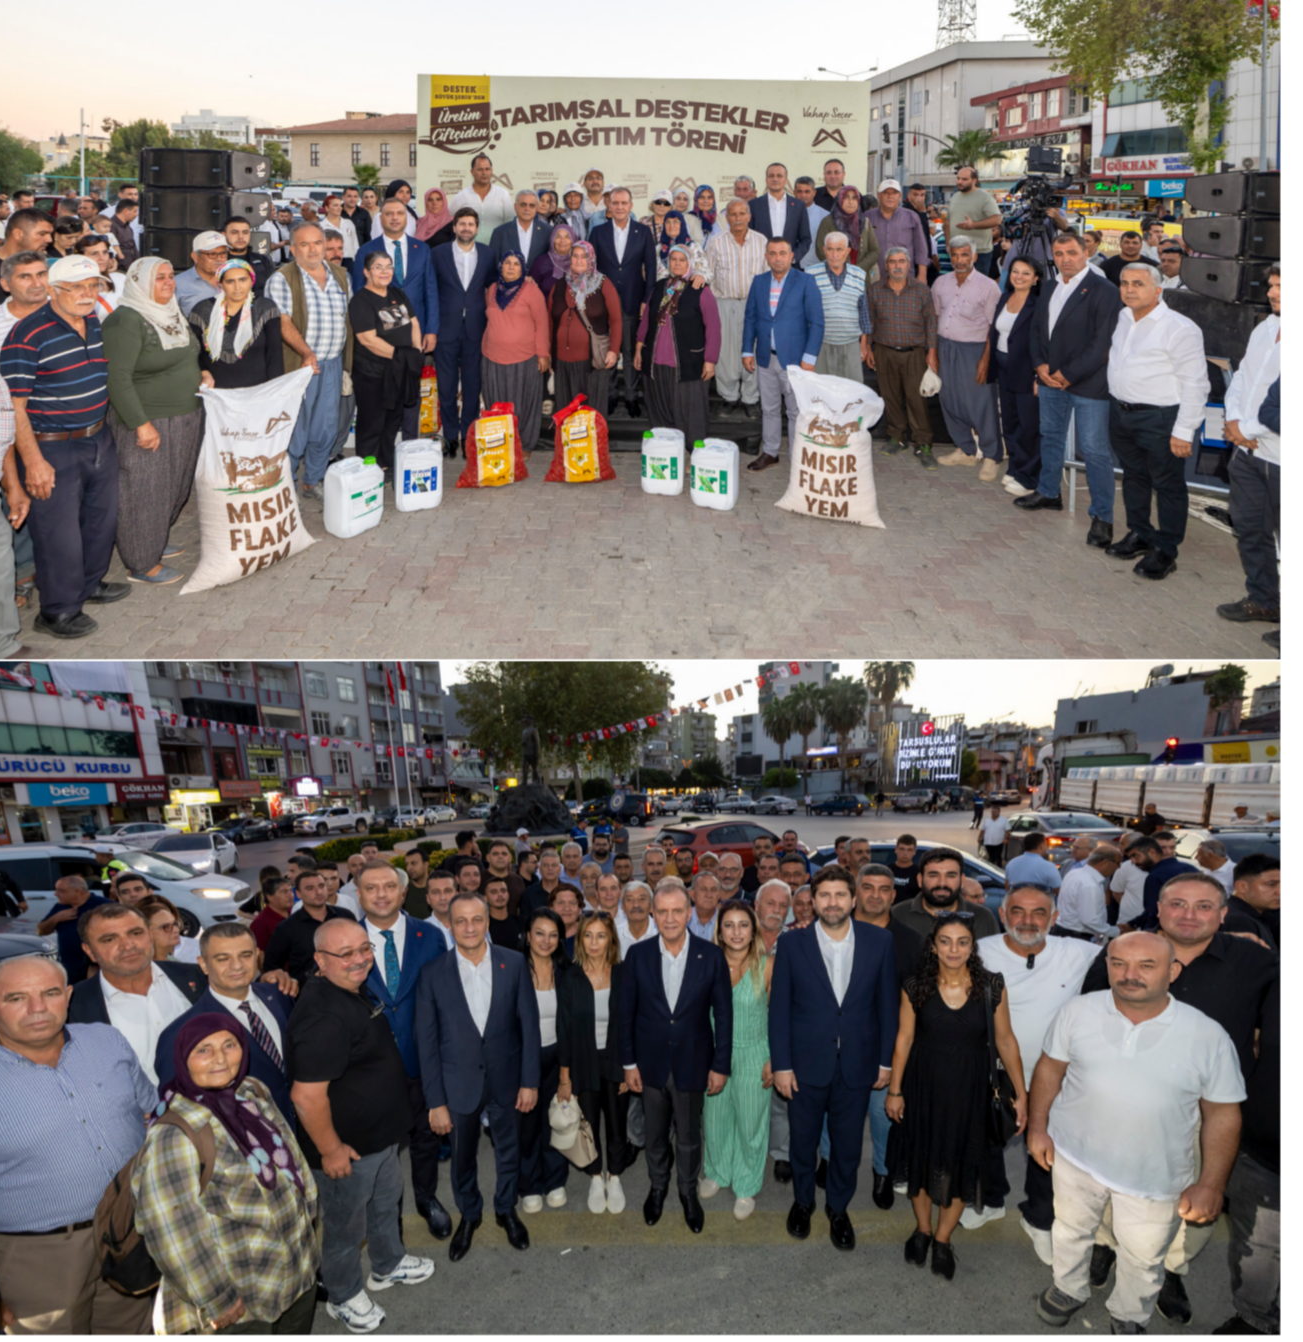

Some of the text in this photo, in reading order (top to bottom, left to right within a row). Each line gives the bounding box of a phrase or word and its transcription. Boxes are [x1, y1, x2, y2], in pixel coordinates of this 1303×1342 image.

[443, 85, 477, 93] DESTEK
[438, 107, 482, 124] Üretim
[494, 99, 790, 134] TARIMSAL DESTEKLER
[803, 105, 830, 123] Vahap
[432, 125, 488, 145] Çiftçiden
[536, 121, 748, 154] DAĞITIM TÖRENİ
[1107, 159, 1157, 172] GÖKHAN
[1161, 181, 1184, 190] beko
[801, 446, 857, 474] MISIR
[799, 469, 858, 498] FLAKE
[226, 486, 293, 524] MISIR
[804, 494, 848, 518] YEM
[230, 508, 297, 551] FLAKE
[239, 540, 291, 576] YEM
[75, 762, 131, 774] KURSU
[49, 784, 90, 797] beko
[121, 783, 165, 793] GÖKHAN
